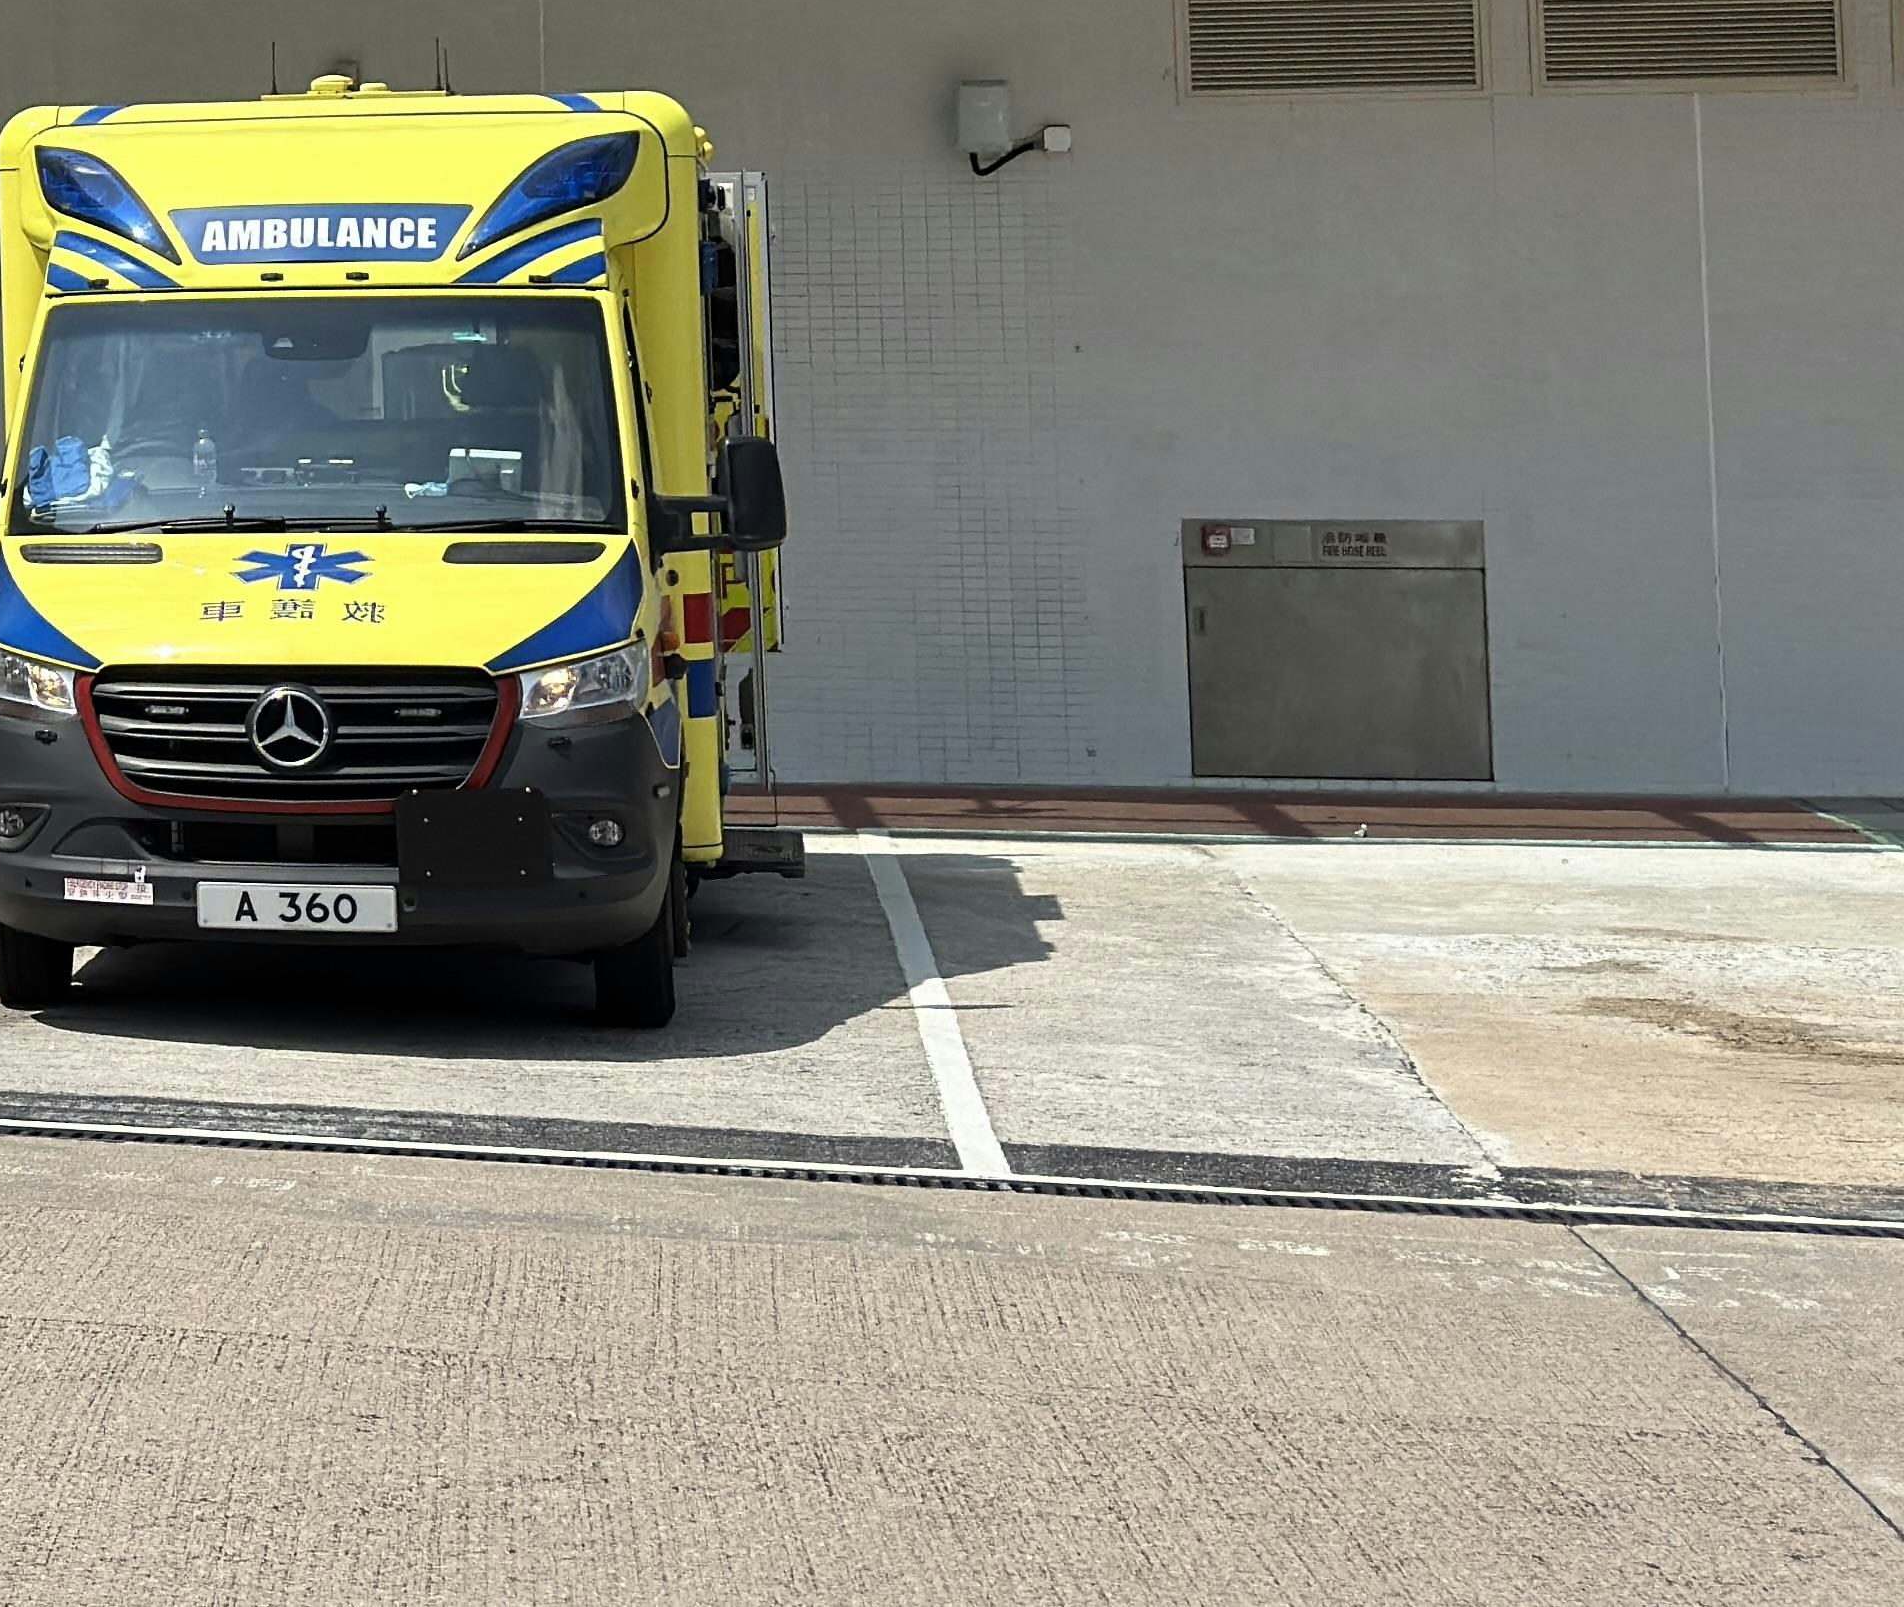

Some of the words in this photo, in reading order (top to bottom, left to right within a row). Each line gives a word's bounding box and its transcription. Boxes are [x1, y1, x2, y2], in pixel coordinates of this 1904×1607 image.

[201, 217, 437, 252] AMBULANCE
[235, 890, 258, 922] A
[278, 892, 358, 924] 360
